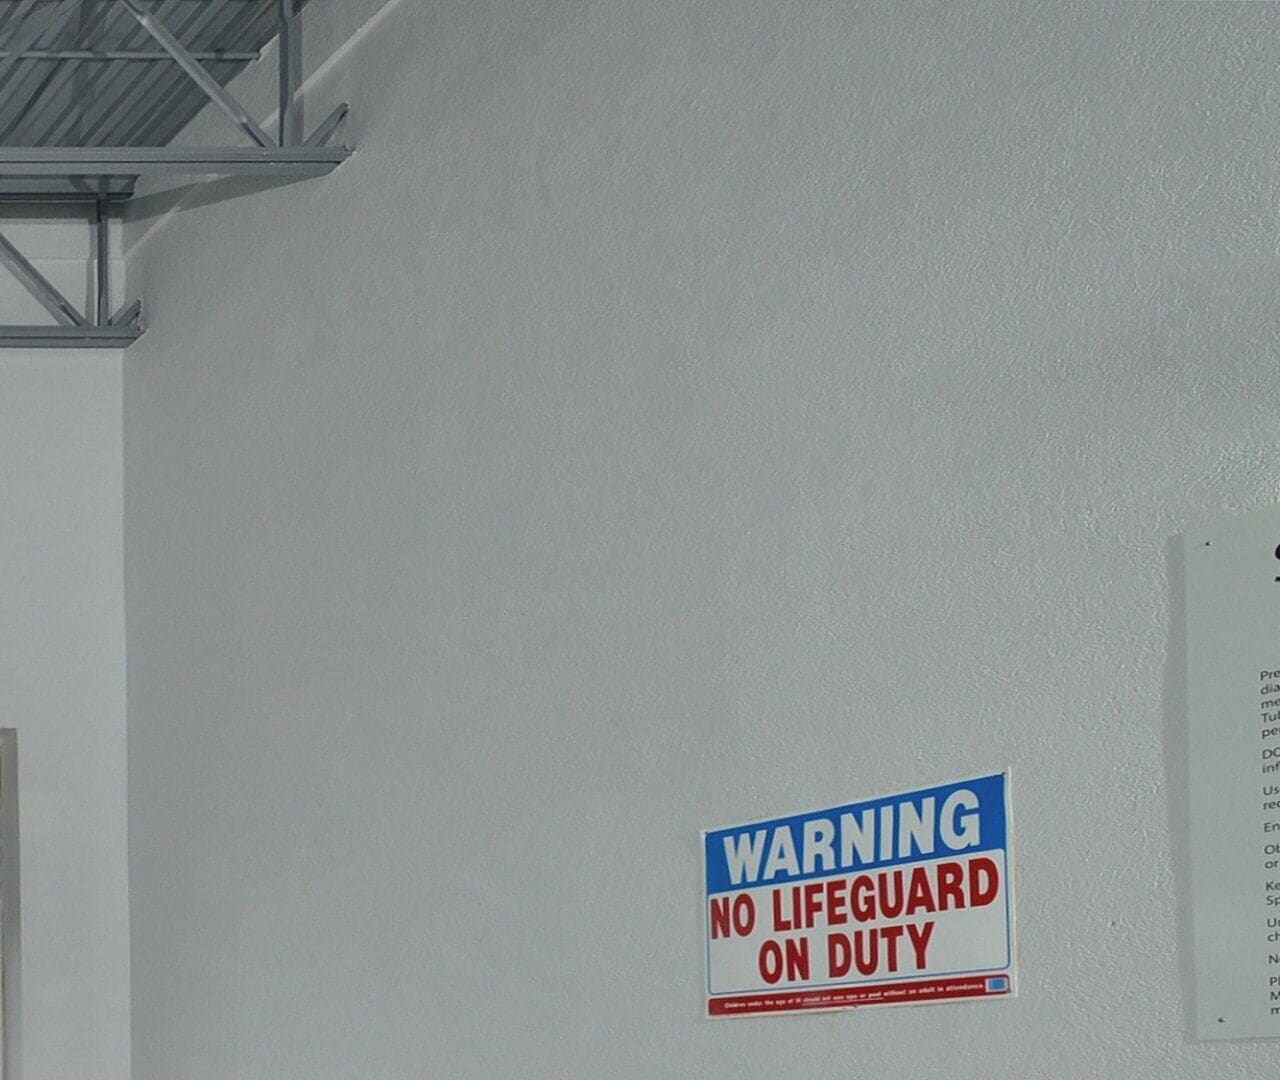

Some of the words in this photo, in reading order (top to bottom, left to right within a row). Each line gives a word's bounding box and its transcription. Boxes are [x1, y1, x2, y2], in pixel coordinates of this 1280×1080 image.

[723, 789, 981, 885] WARNING
[710, 893, 756, 940] NO
[773, 857, 1000, 932] LIFEGUARD
[758, 937, 810, 985] ON
[827, 921, 935, 978] DUTY
